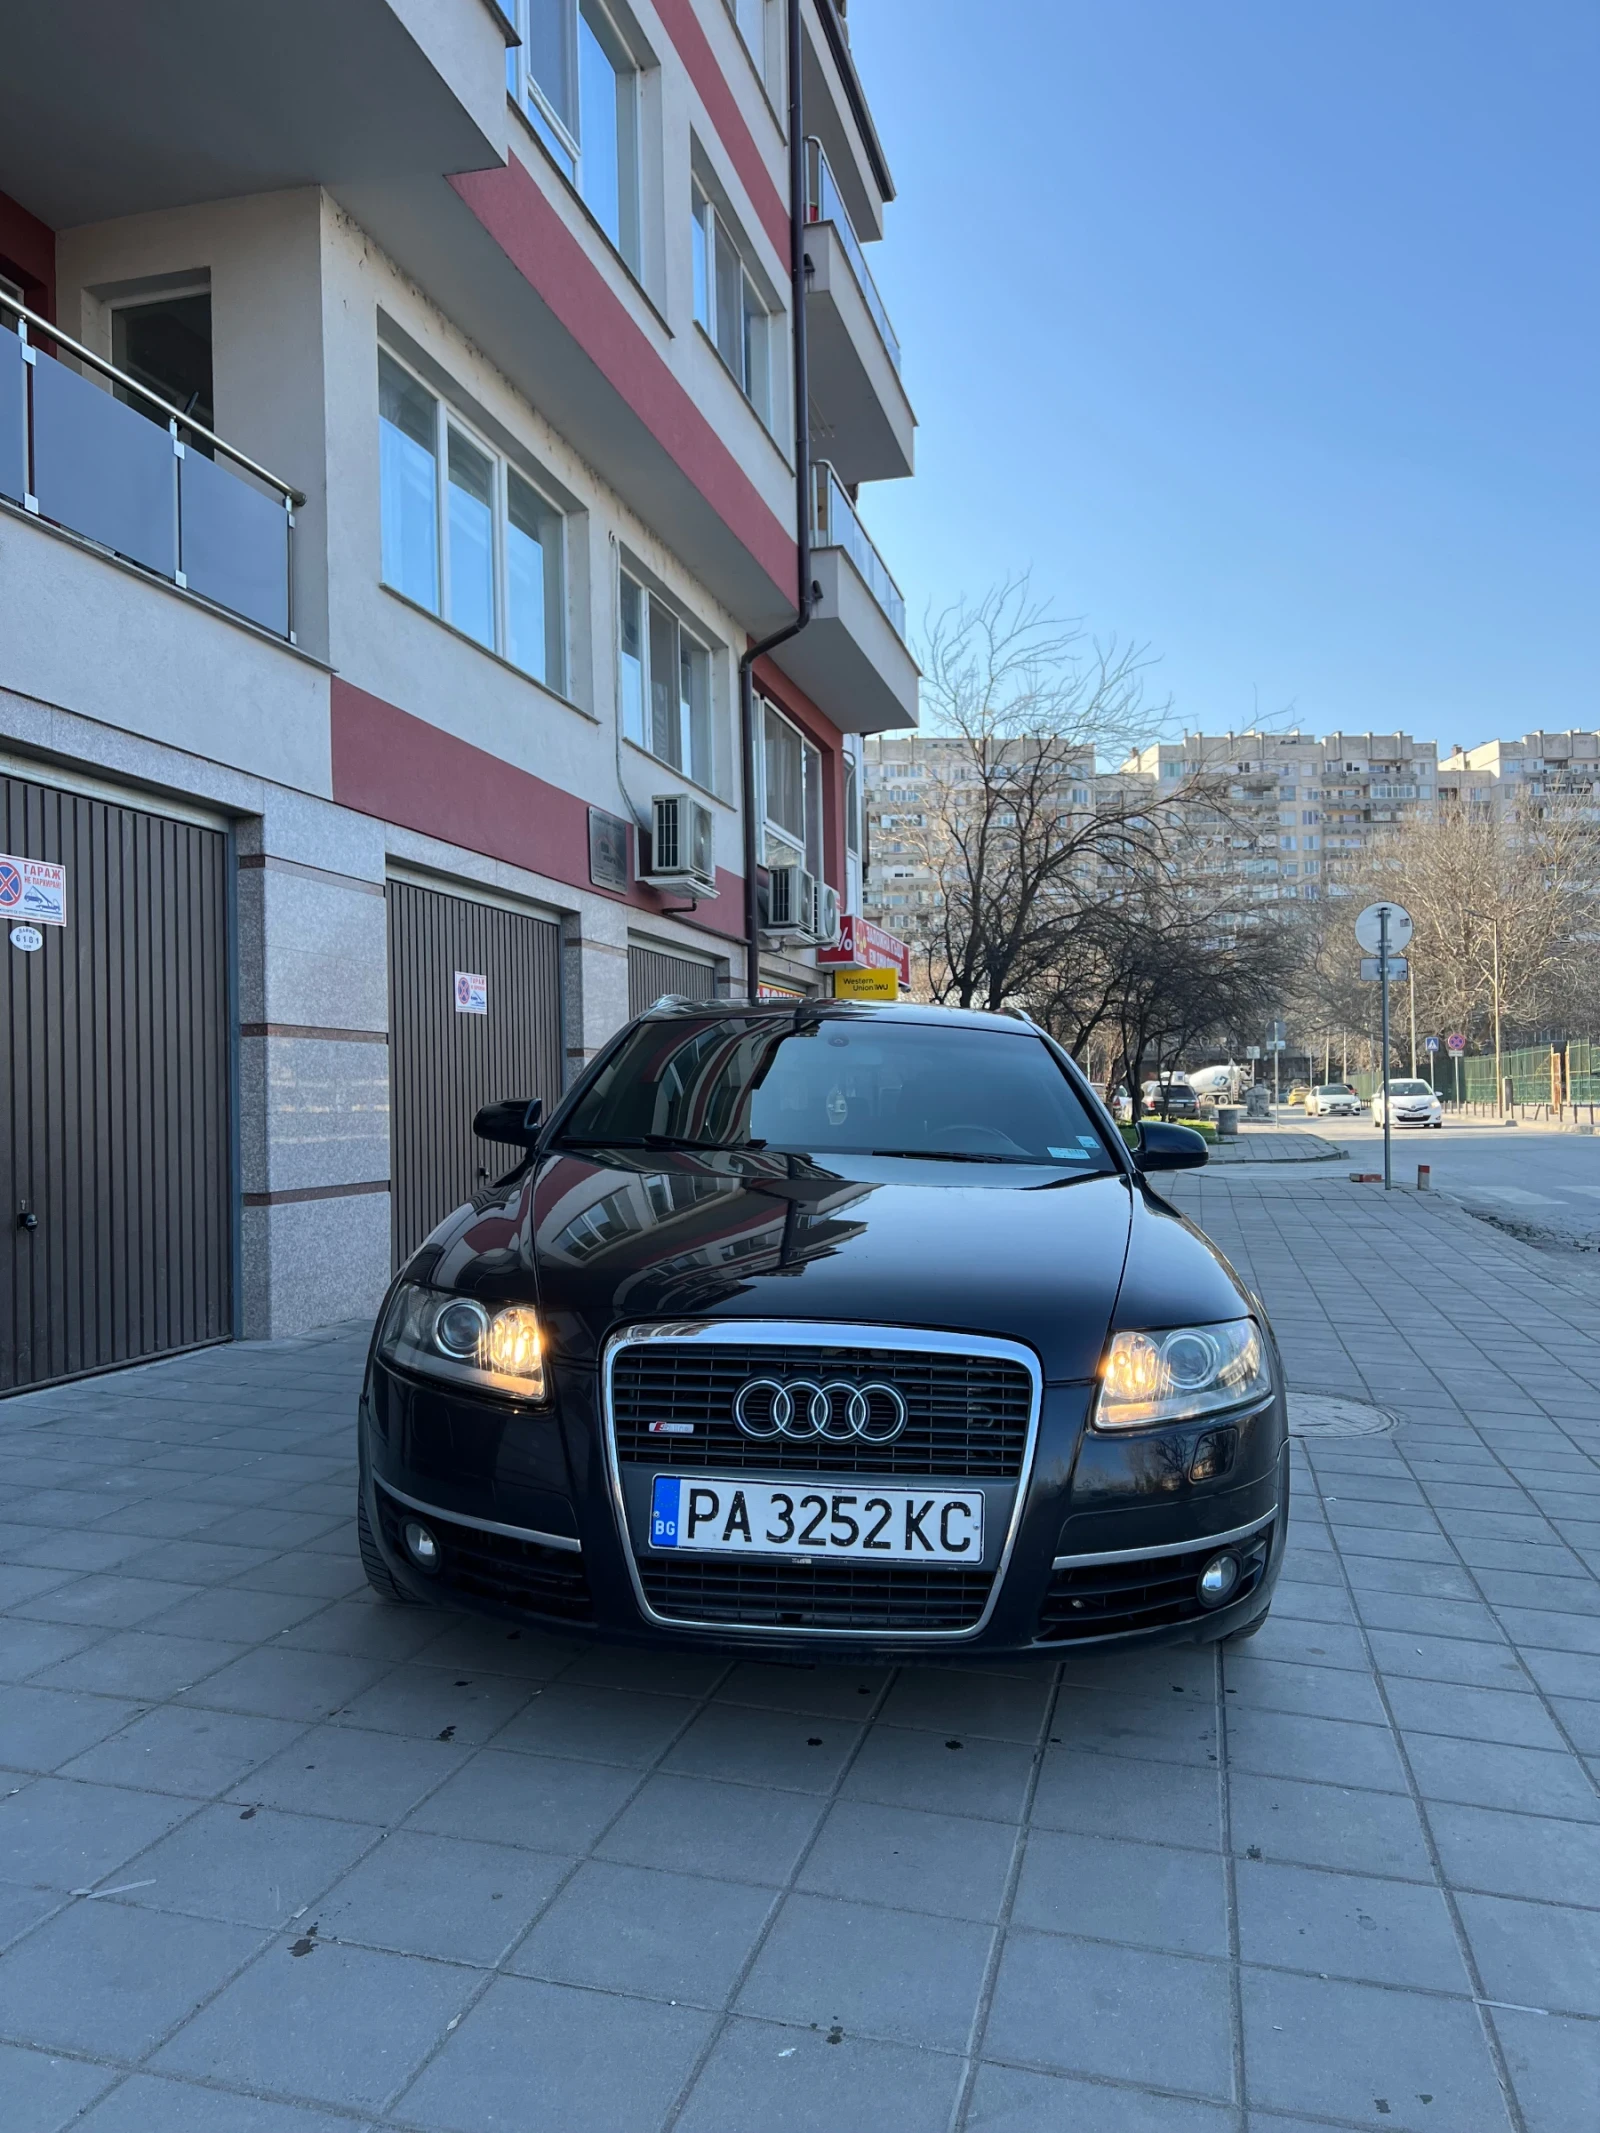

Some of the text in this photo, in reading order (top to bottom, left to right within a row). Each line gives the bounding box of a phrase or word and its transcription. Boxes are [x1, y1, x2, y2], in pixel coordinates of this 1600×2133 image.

[24, 864, 61, 880] ГАРАЖ
[24, 876, 31, 884] НЕ
[655, 1519, 675, 1536] BG
[687, 1488, 971, 1553] PA 3252 KC
